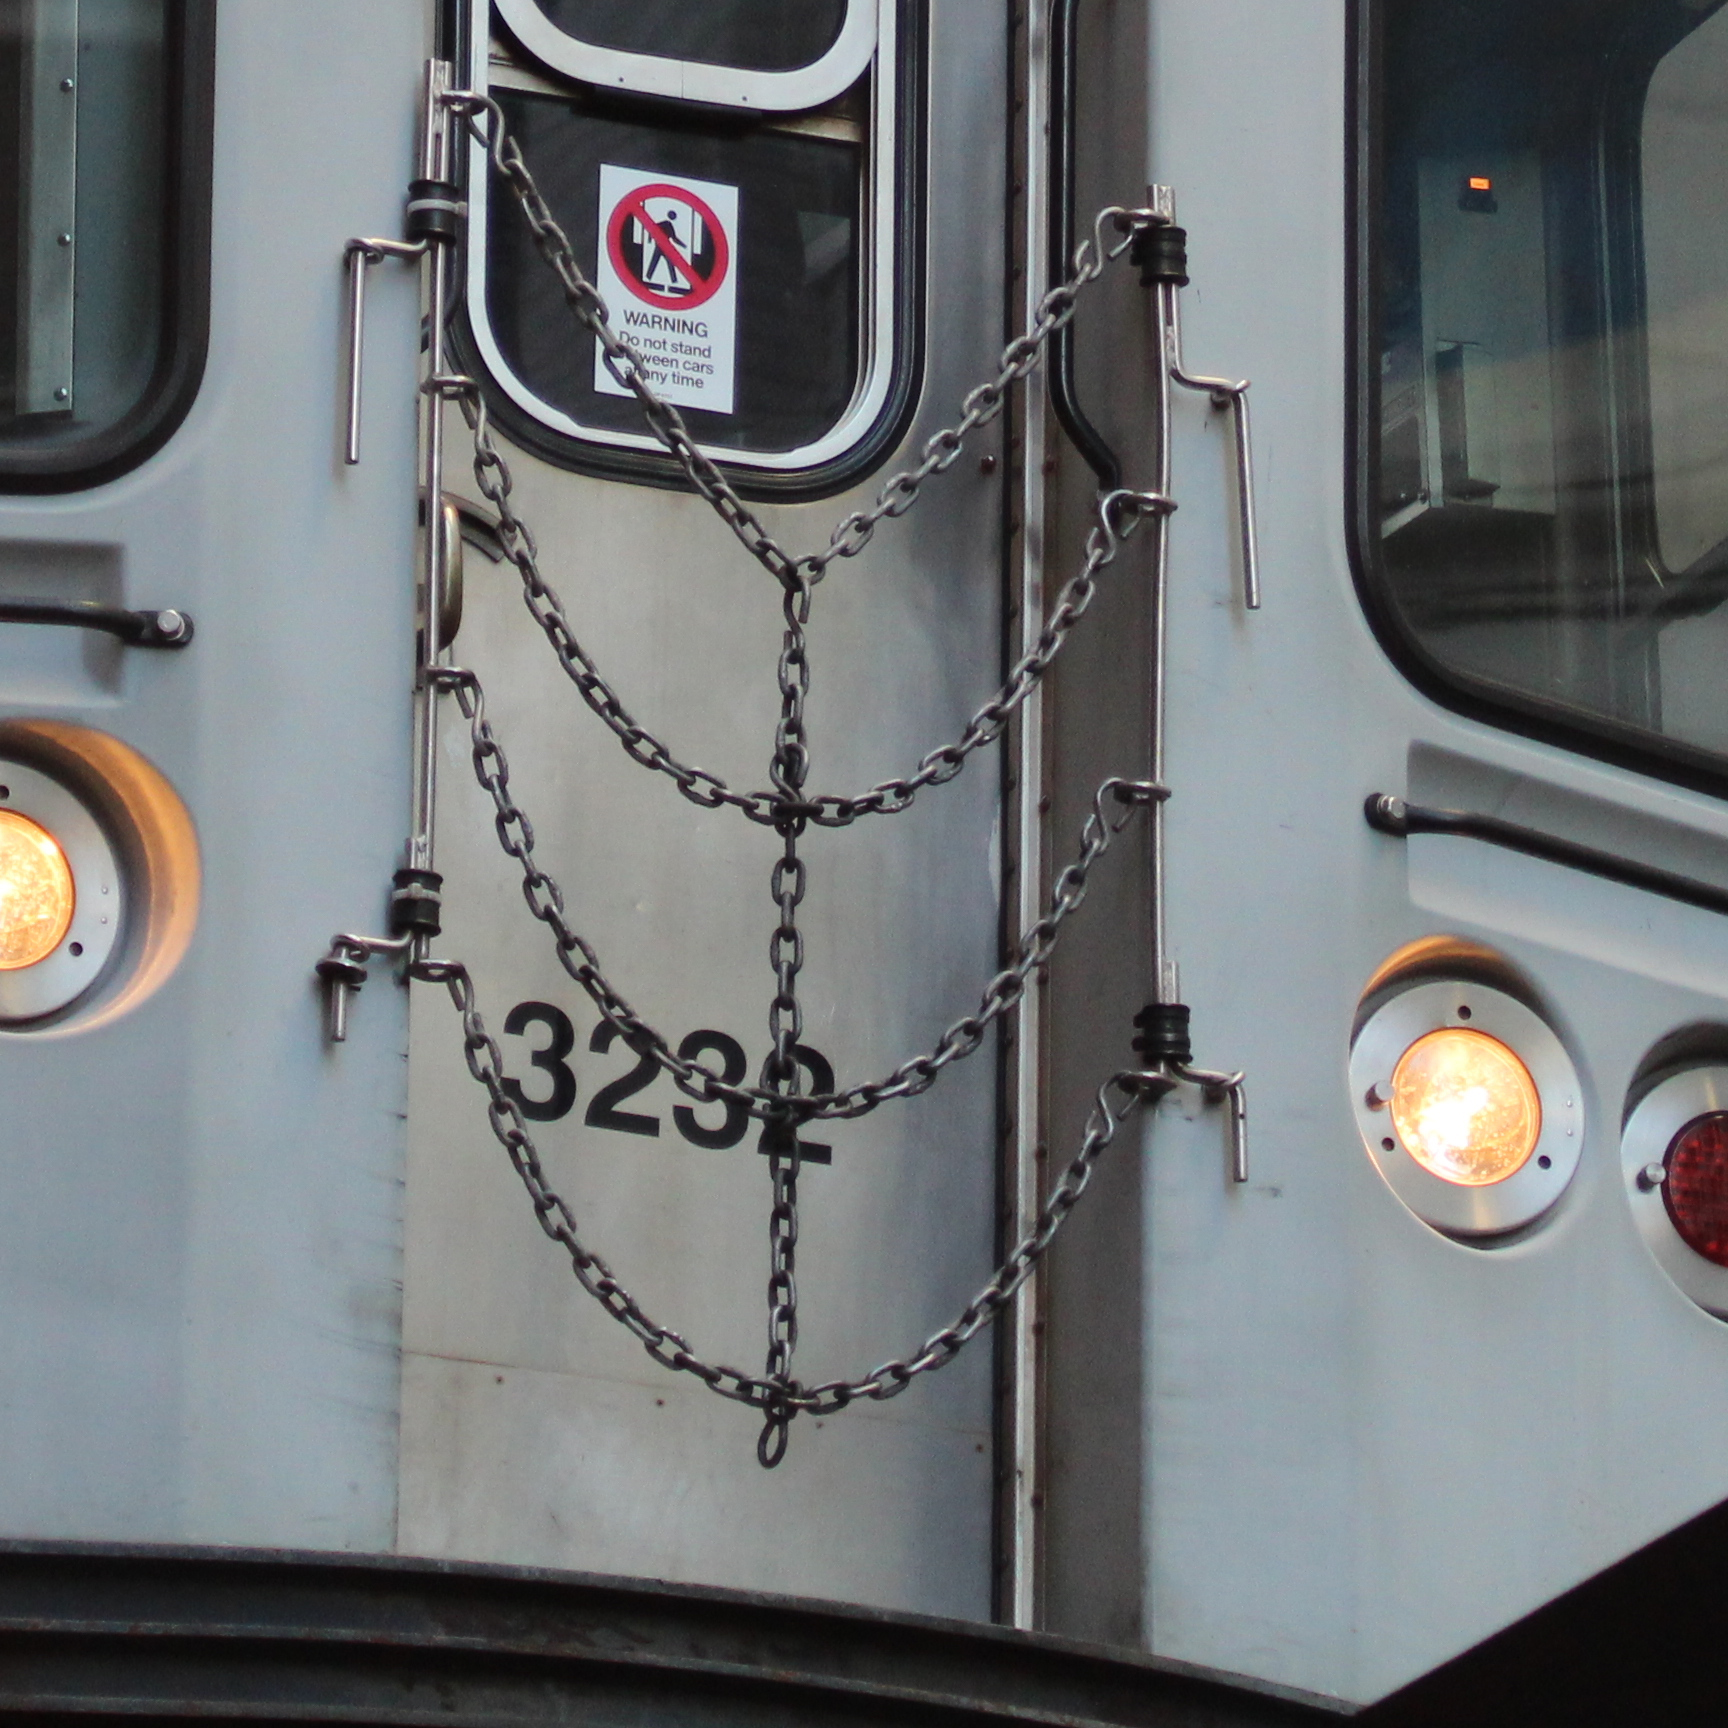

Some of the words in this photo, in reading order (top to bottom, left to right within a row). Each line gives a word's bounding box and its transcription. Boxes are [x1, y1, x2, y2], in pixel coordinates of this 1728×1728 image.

[624, 309, 708, 338] WARNING
[619, 330, 640, 347] Do
[643, 338, 667, 351] not
[670, 341, 711, 358] stand
[672, 372, 704, 389] time
[683, 360, 714, 375] cars
[500, 1001, 835, 1166] 3232
